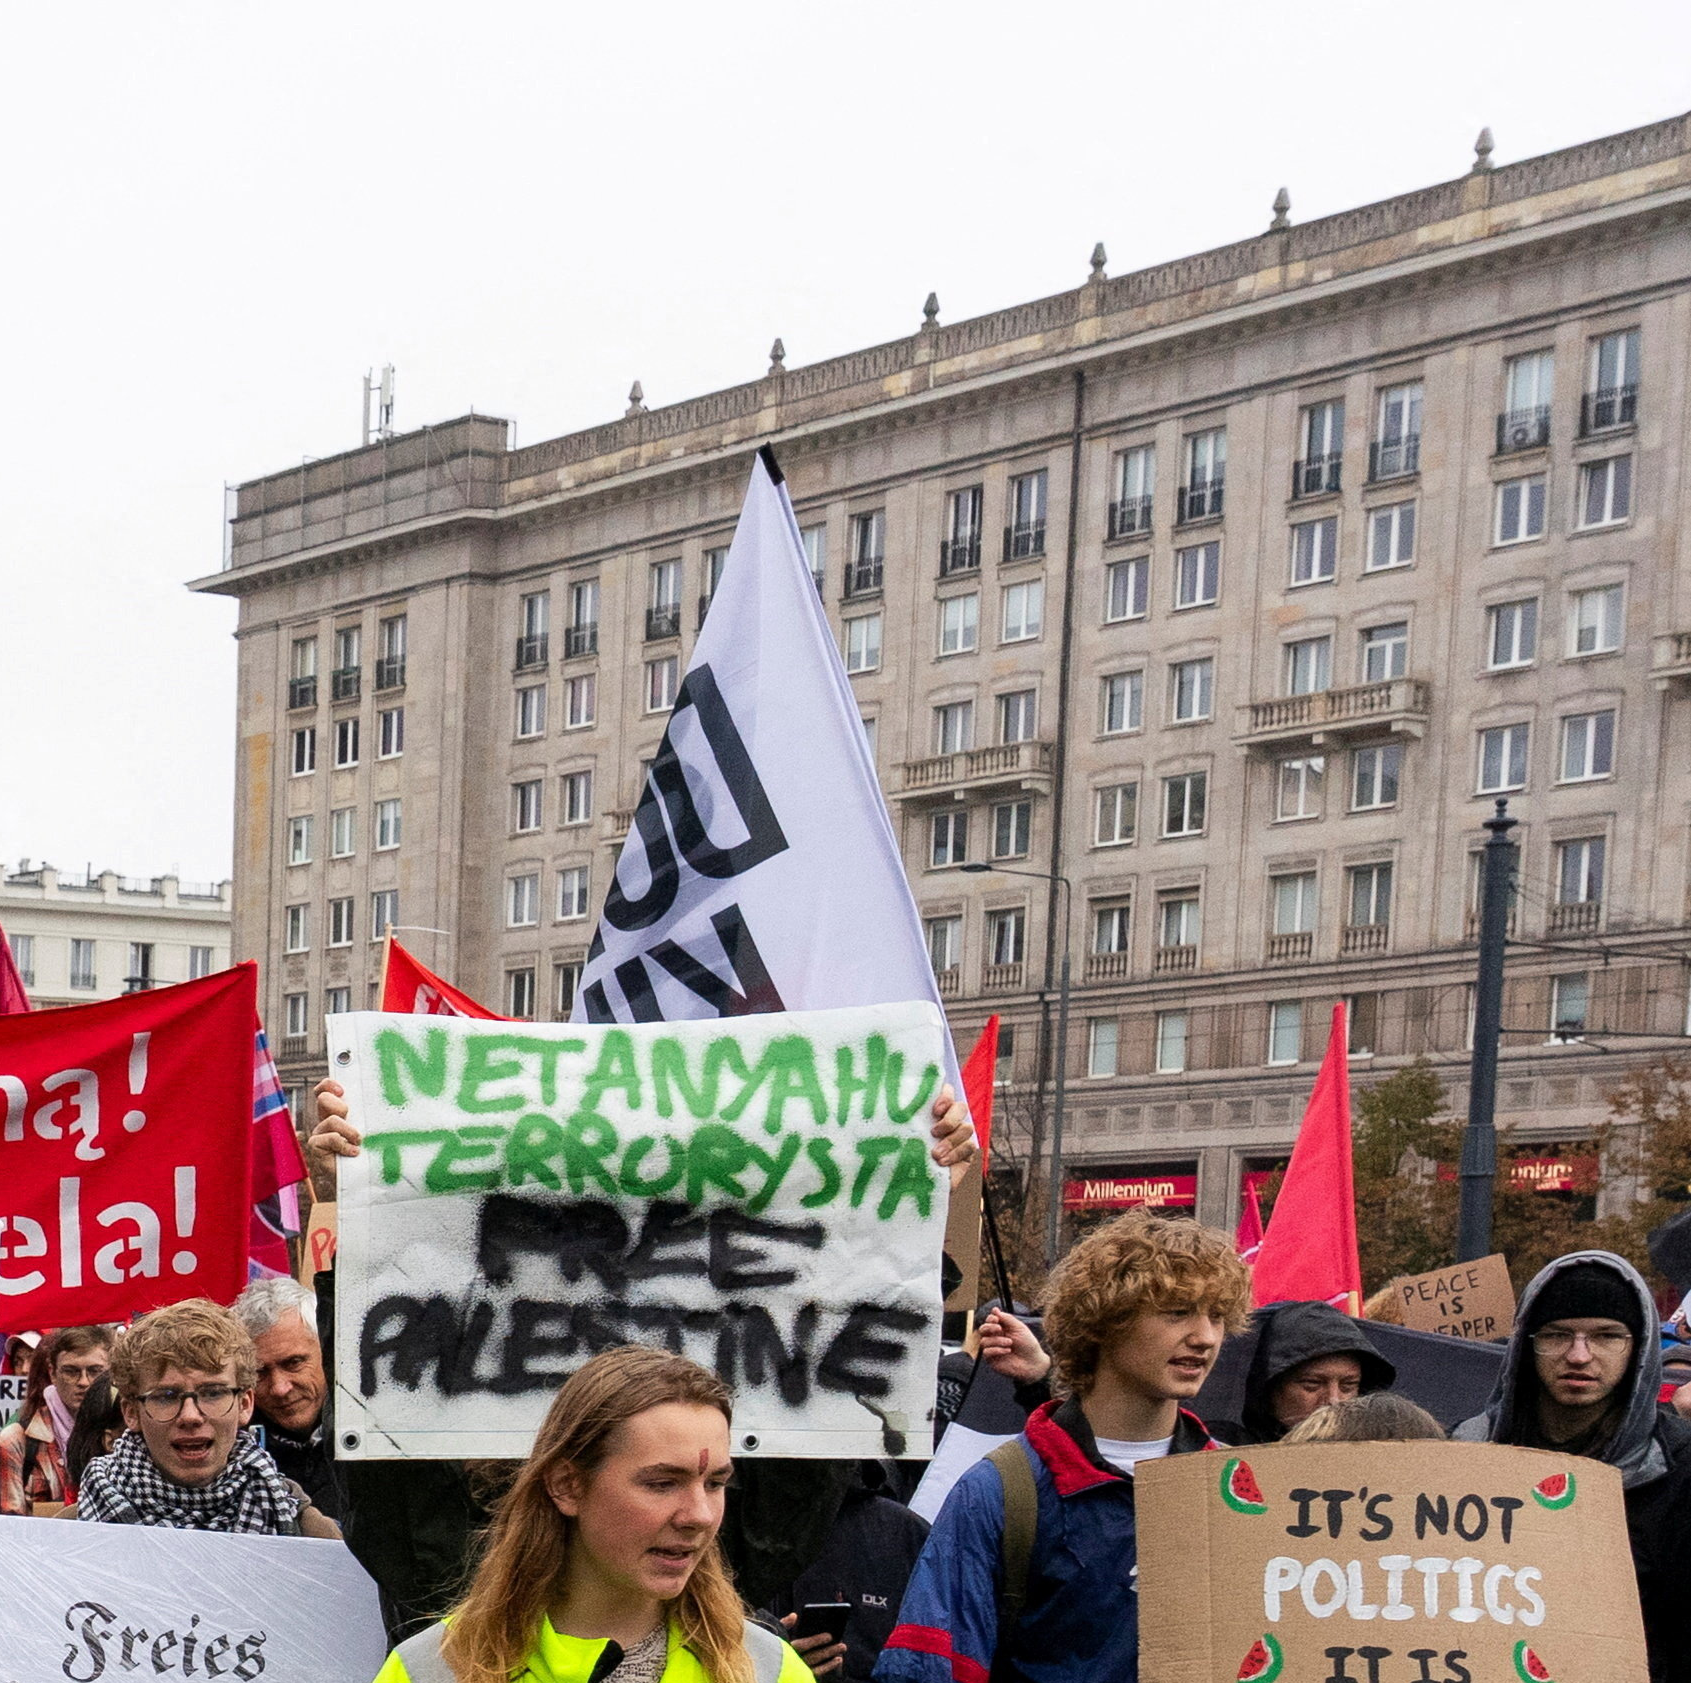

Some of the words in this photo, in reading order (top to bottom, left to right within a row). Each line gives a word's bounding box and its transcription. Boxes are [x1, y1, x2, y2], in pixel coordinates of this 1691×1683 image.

[373, 1029, 940, 1135] NETANYAHU
[363, 1113, 937, 1222] TERRORYSTA
[1083, 1179, 1175, 1200] Millennium
[476, 1195, 827, 1292] FREE
[1402, 1268, 1480, 1306] PEACE
[1439, 1296, 1464, 1317] IS
[1434, 1316, 1497, 1340] EAPER
[1285, 1486, 1394, 1542] IT'S
[1414, 1492, 1524, 1543] NOT
[861, 1593, 888, 1607] DLX
[1263, 1554, 1546, 1627] POLITICS
[61, 1600, 268, 1683] Freies
